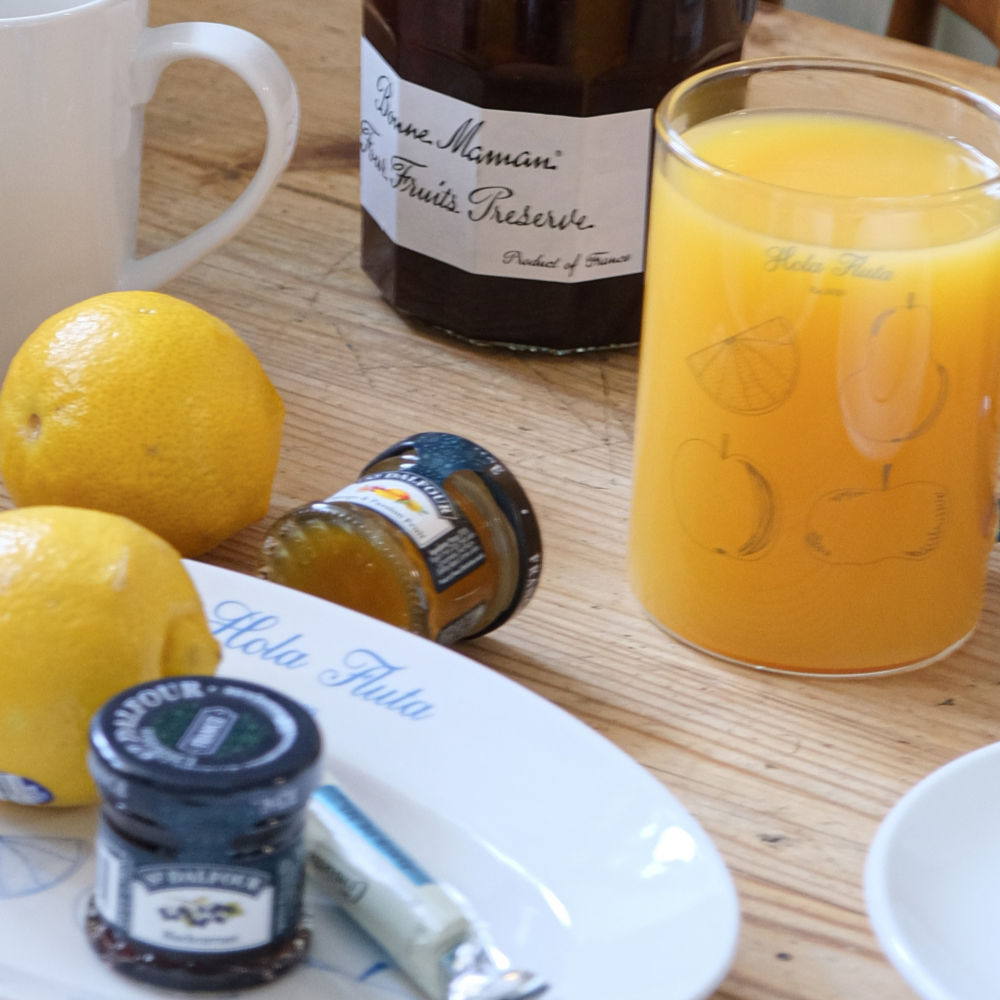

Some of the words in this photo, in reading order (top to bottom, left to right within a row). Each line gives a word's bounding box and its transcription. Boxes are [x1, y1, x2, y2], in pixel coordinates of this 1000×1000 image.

[374, 75, 433, 146] Bonne
[387, 154, 461, 215] Fruits
[467, 185, 596, 231] Preserve
[502, 249, 561, 269] Product
[562, 253, 581, 277] of
[584, 251, 632, 269] France
[763, 245, 825, 273] Hola
[207, 599, 311, 670] Hola
[317, 647, 436, 721] Fluta
